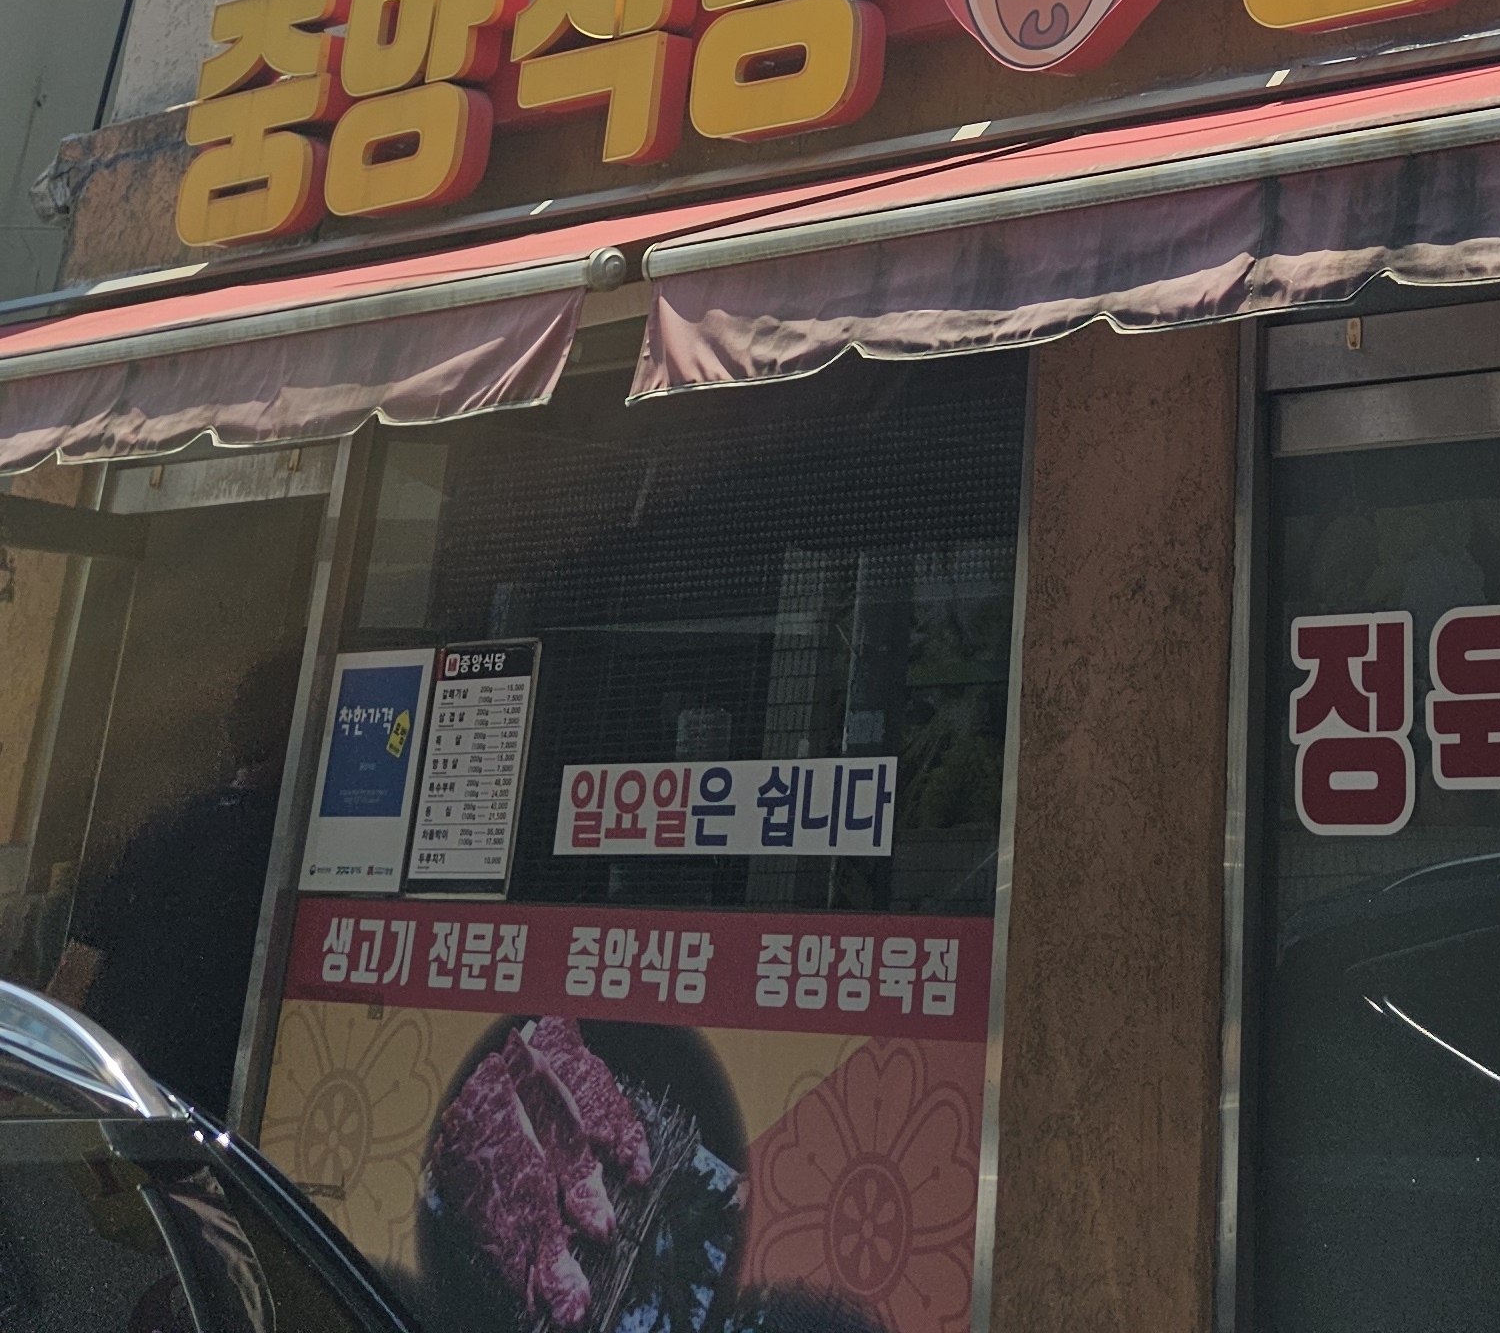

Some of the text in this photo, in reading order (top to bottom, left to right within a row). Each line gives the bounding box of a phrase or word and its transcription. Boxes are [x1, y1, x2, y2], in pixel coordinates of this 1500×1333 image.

[460, 652, 506, 673] 중앙식당
[338, 705, 394, 736] 착한가격
[569, 763, 893, 848] 일요일은 쉽니다
[321, 917, 960, 1016] 생고기 전문점 중앙식당 중앙정육점
